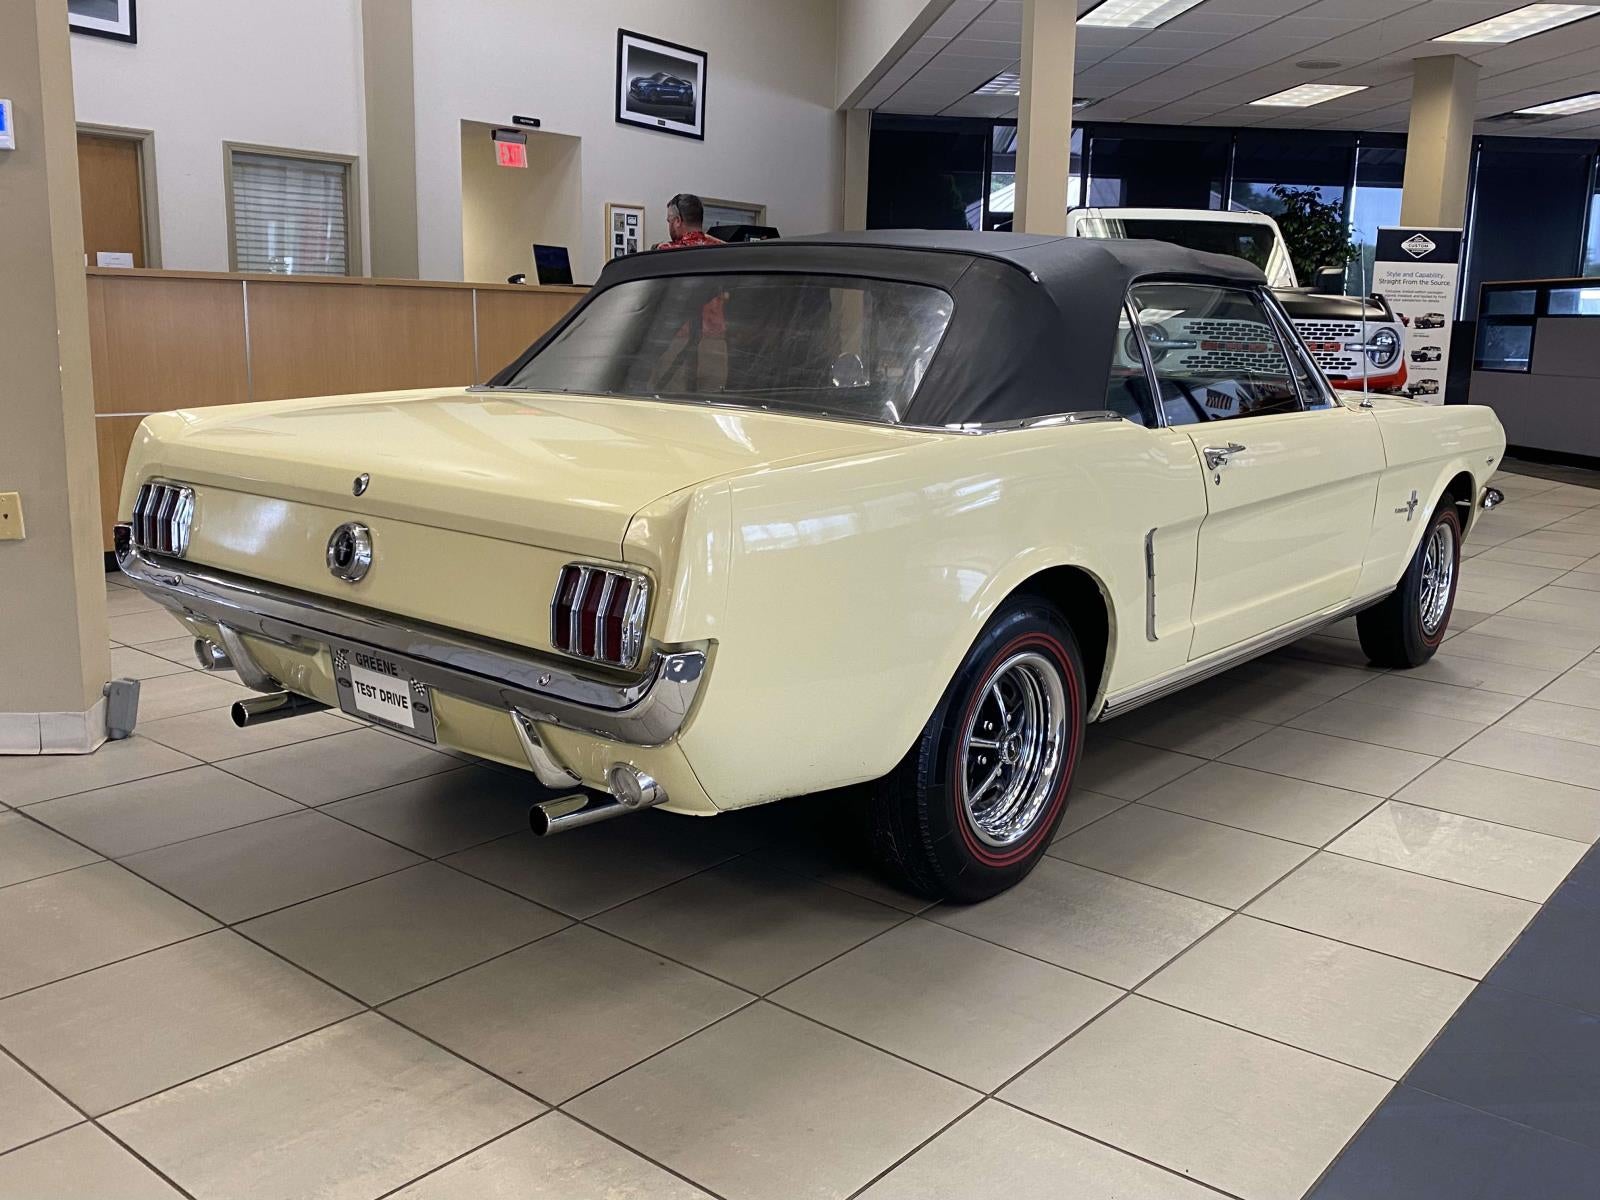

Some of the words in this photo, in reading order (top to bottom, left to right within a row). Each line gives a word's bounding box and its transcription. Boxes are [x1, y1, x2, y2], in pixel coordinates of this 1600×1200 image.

[355, 653, 398, 676] GREENE
[355, 680, 377, 699] TEST
[379, 689, 409, 709] DRIVE
